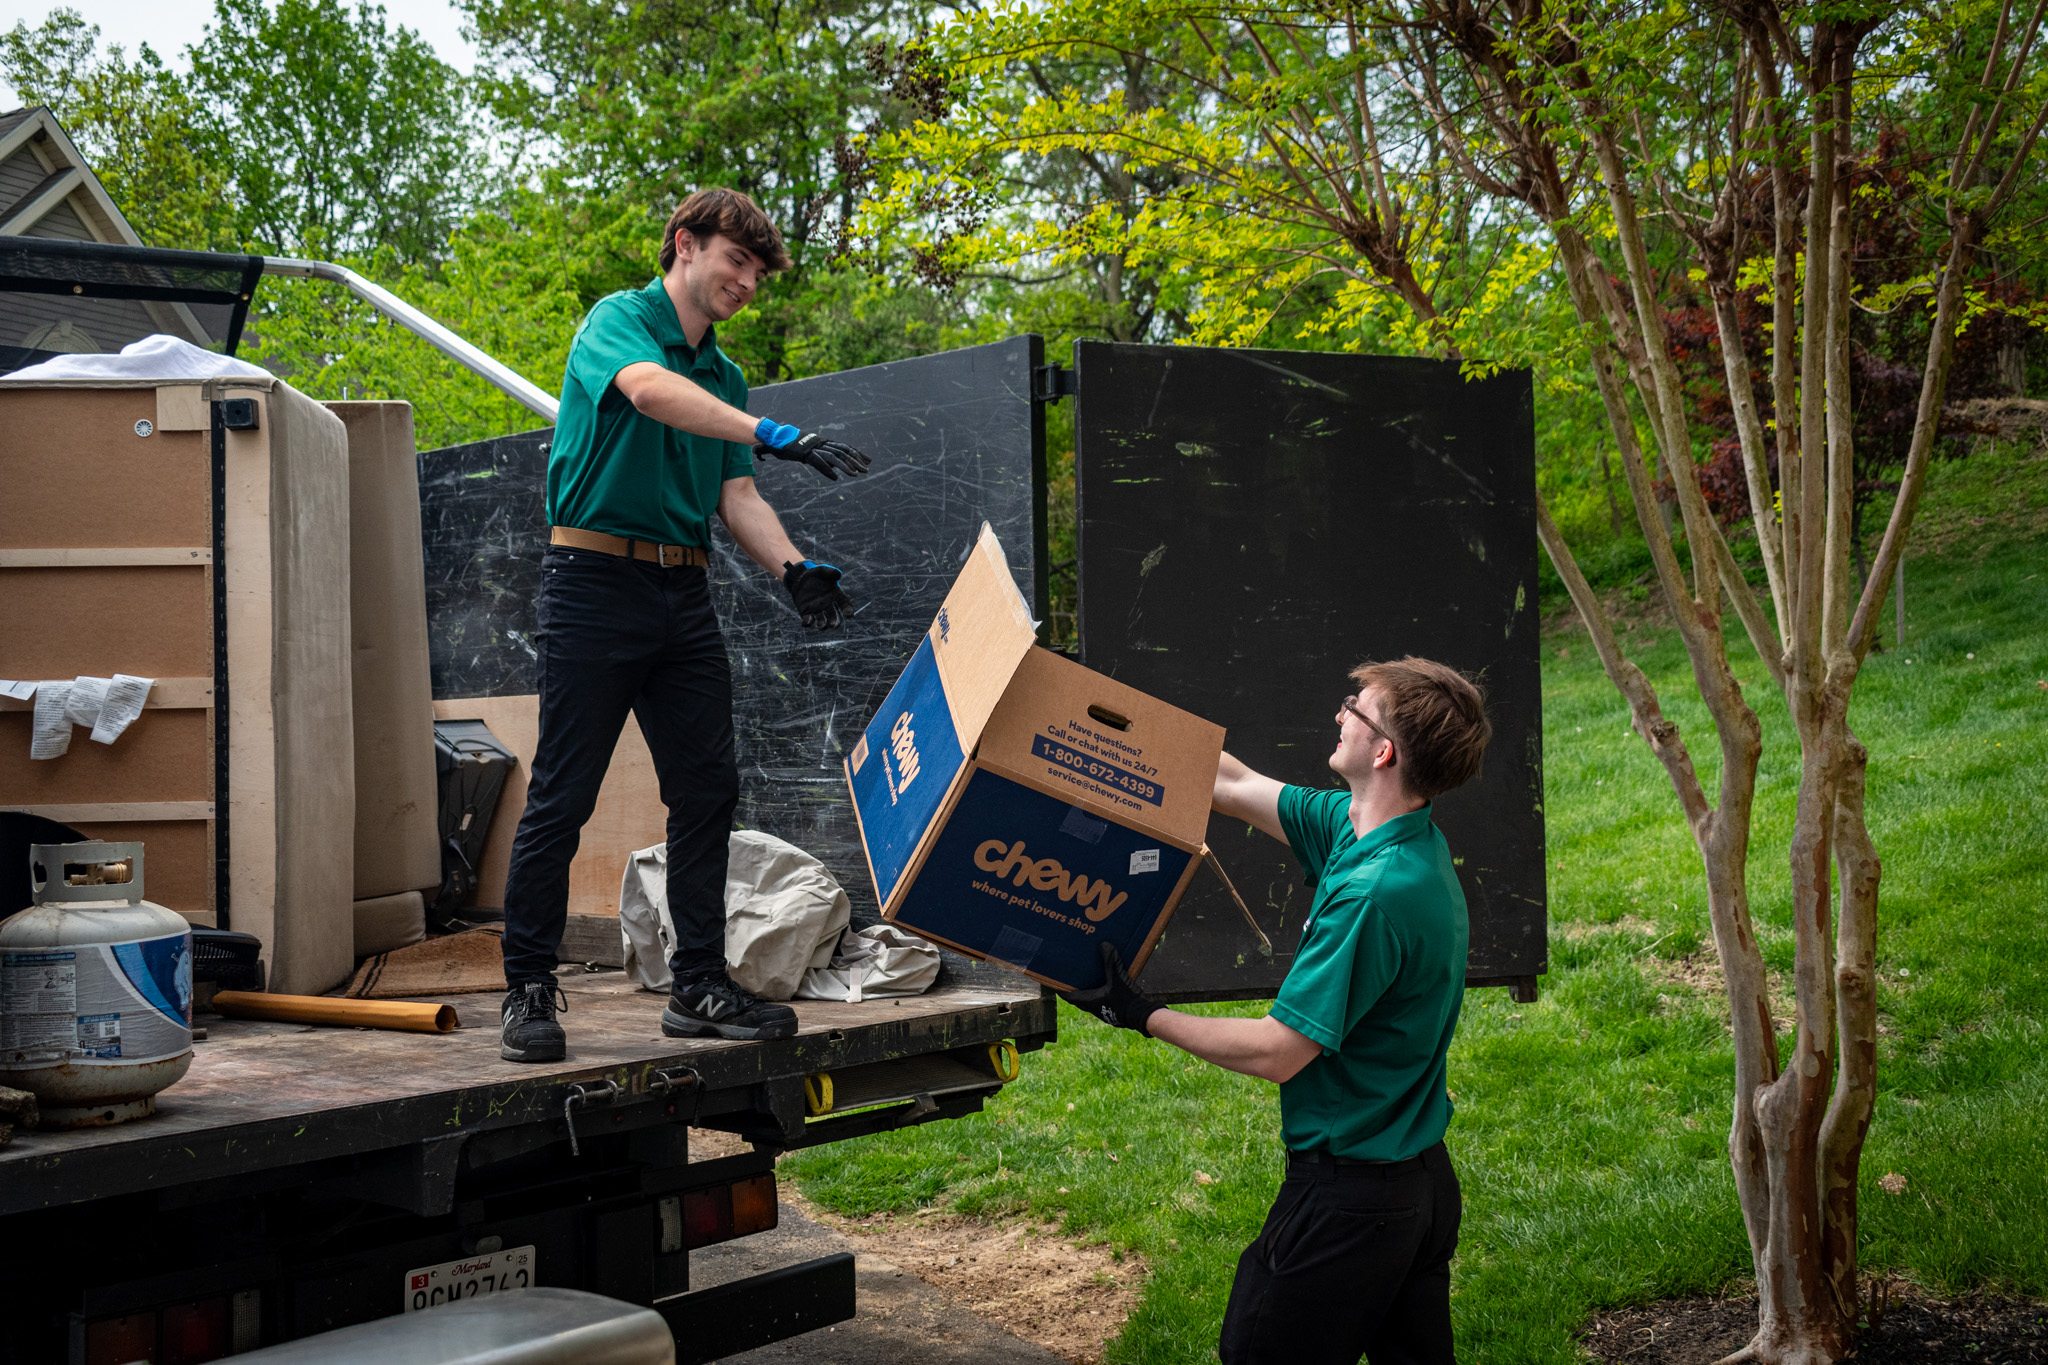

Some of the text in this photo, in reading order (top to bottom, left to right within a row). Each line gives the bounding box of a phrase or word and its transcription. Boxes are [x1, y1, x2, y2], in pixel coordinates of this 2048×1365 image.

[891, 711, 920, 794] chewy
[1047, 725, 1158, 777] Call or chat with us 24/7
[1068, 720, 1142, 757] Have questions?
[1043, 743, 1155, 798] 1-800-672-4399
[1047, 766, 1142, 811] service@chewy.com
[974, 839, 1128, 922] chewy
[972, 880, 1096, 935] where pet lovers shop
[695, 994, 726, 1018] N
[418, 1276, 425, 1287] 3
[451, 1257, 493, 1276] Maryland
[518, 1254, 528, 1264] 25
